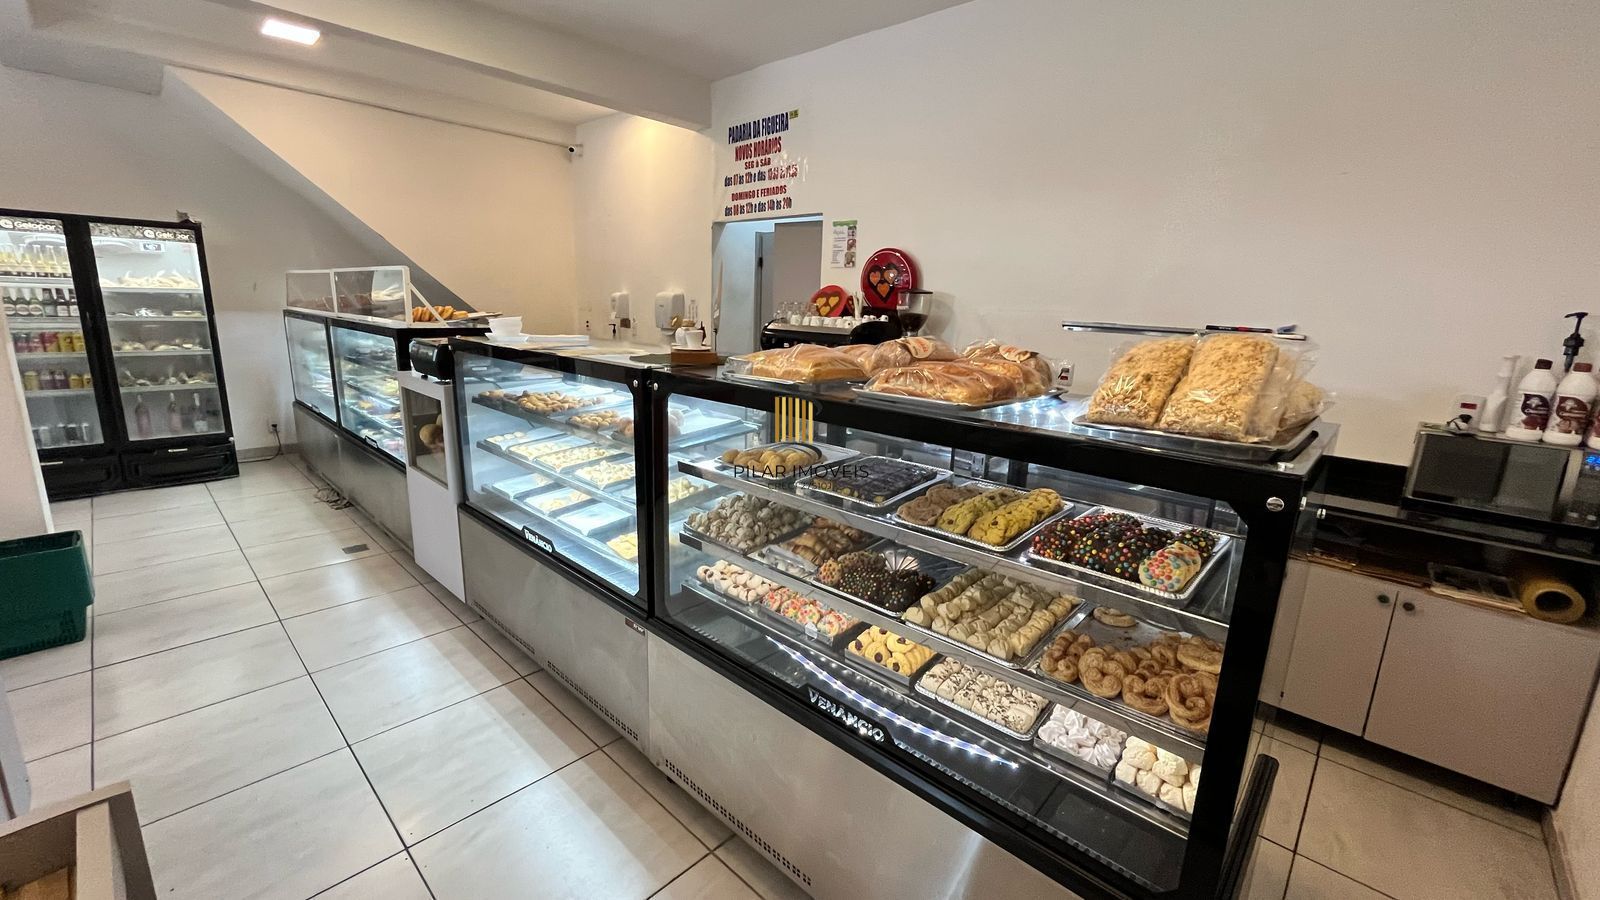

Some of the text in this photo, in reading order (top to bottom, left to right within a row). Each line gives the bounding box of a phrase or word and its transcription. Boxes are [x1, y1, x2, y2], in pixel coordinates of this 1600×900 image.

[728, 121, 752, 145] PADARIA
[752, 119, 761, 139] DA
[761, 112, 789, 136] FIGUEIRA
[735, 136, 782, 162] NOVOS HORÁRIOS
[744, 160, 754, 170] SEG
[724, 176, 732, 187] das
[757, 170, 766, 181] das
[731, 184, 787, 202] DOMINGO E FERIADOS
[724, 205, 733, 217] das
[757, 200, 767, 213] das
